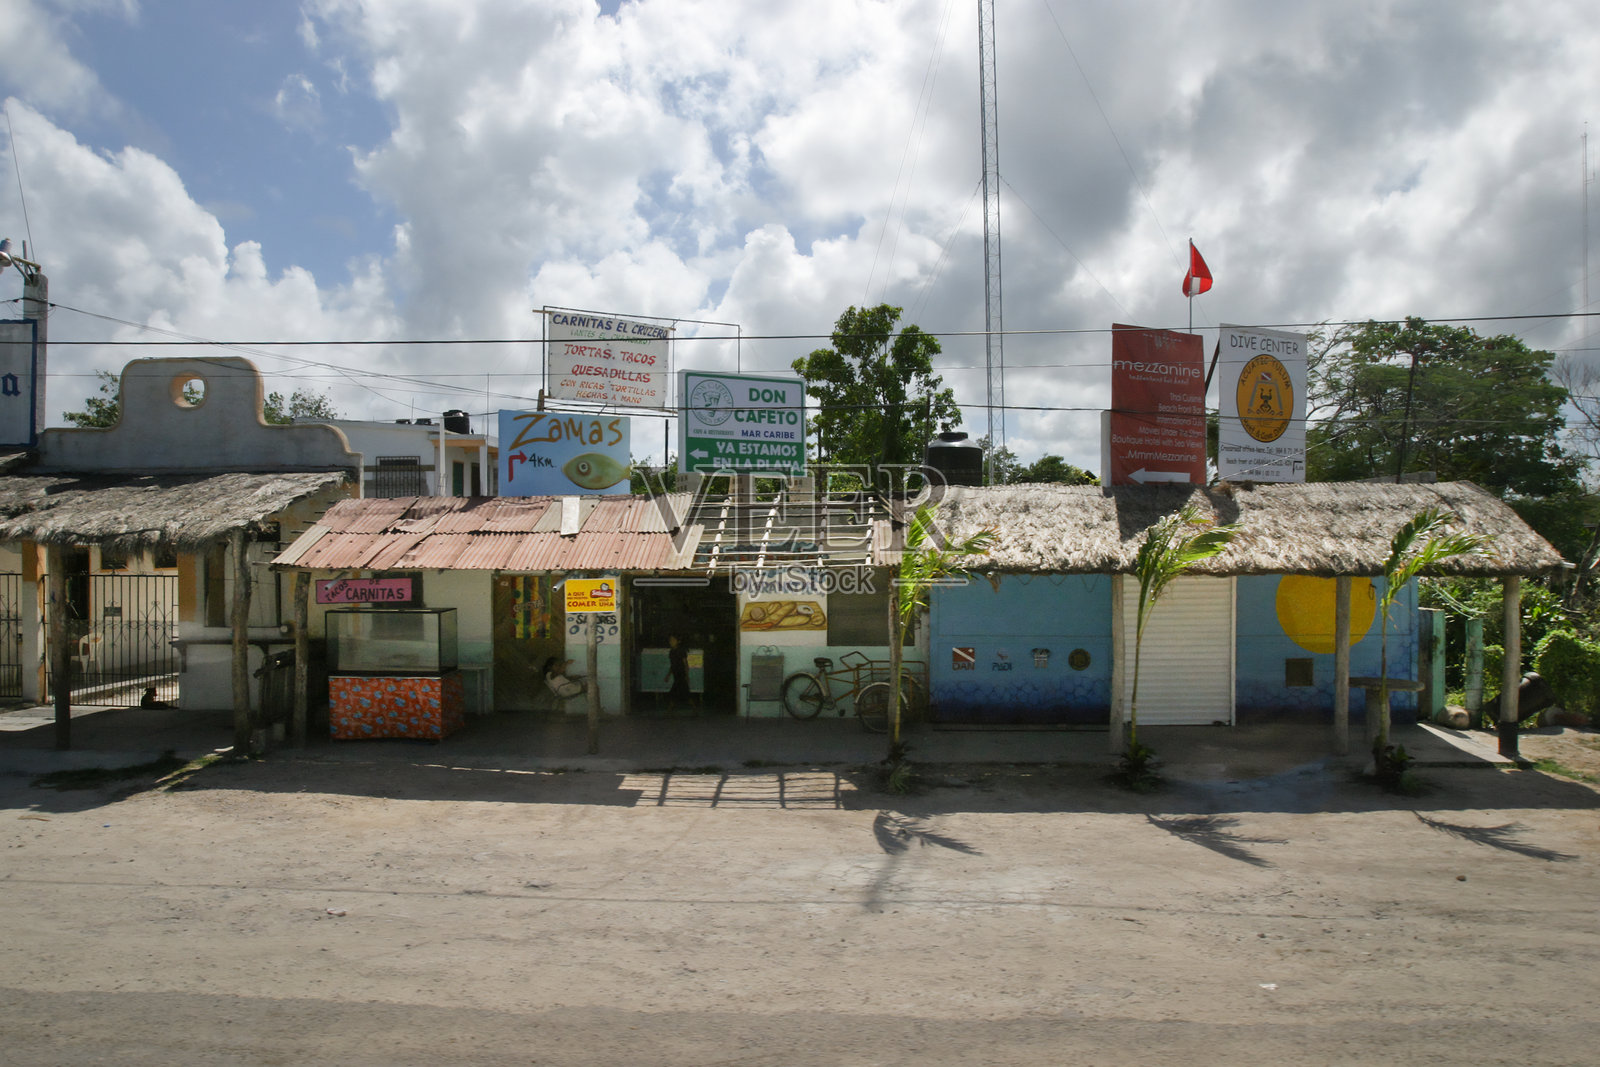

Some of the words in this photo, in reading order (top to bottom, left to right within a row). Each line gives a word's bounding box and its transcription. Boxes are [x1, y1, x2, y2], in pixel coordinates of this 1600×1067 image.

[553, 314, 613, 331] CARNITAS
[616, 322, 628, 334] EL
[631, 324, 669, 339] CRUZERO
[1230, 334, 1257, 350] DIVE
[1260, 338, 1299, 354] CENTER
[620, 351, 657, 366] TACOS
[571, 364, 651, 384] QUESADILLAS
[1113, 360, 1201, 378] mezzanine
[560, 379, 575, 388] CON
[580, 381, 605, 391] RICAS
[610, 383, 656, 397] TORTILLAS
[576, 390, 608, 400] HECHAS
[748, 387, 787, 404] DON
[734, 409, 798, 425] CAFETO
[741, 429, 761, 438] MAR
[763, 430, 795, 439] CARIBE
[716, 441, 735, 454] YA
[739, 442, 797, 457] ESTAMOS
[713, 457, 732, 468] EN
[325, 581, 349, 601] TACOS
[346, 588, 404, 600] CARNITAS
[952, 663, 975, 671] DAN
